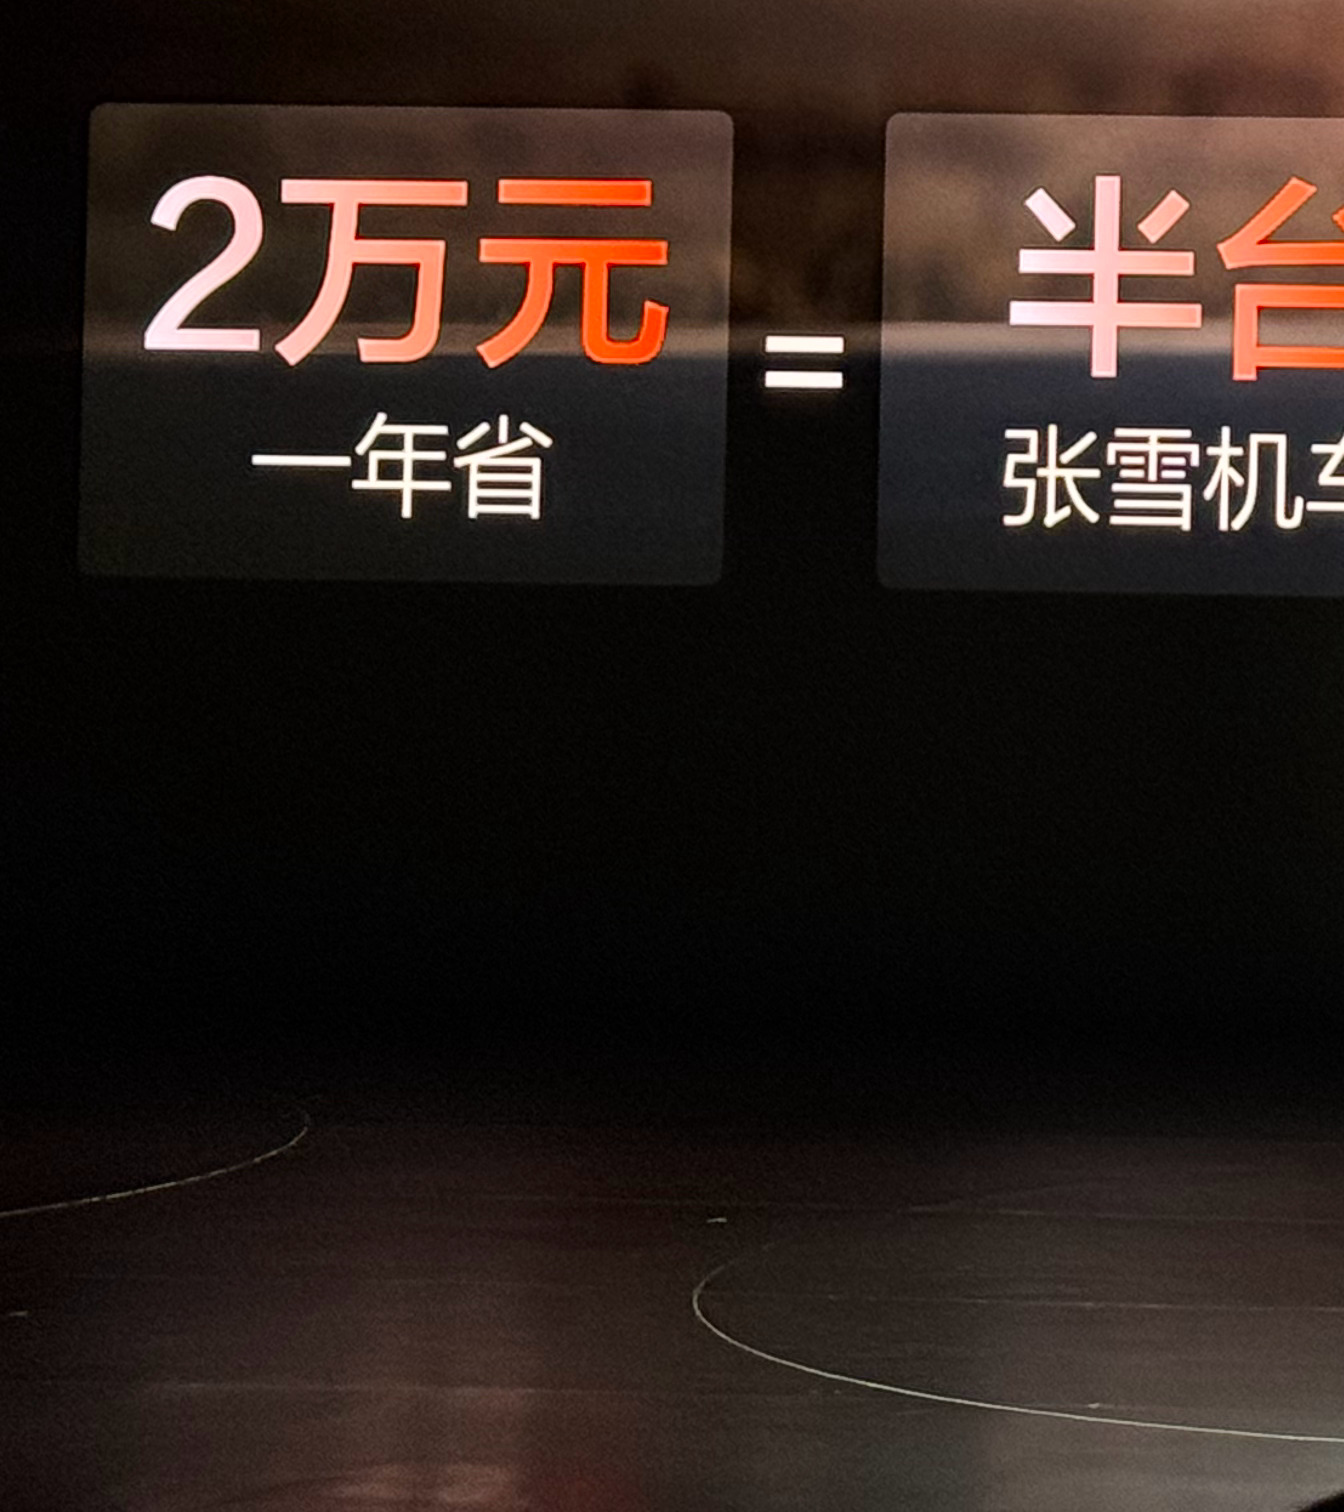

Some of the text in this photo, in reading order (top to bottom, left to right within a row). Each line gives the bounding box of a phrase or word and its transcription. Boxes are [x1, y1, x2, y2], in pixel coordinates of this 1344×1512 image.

[144, 175, 670, 368] 2万元
[252, 412, 553, 519] 一年省
